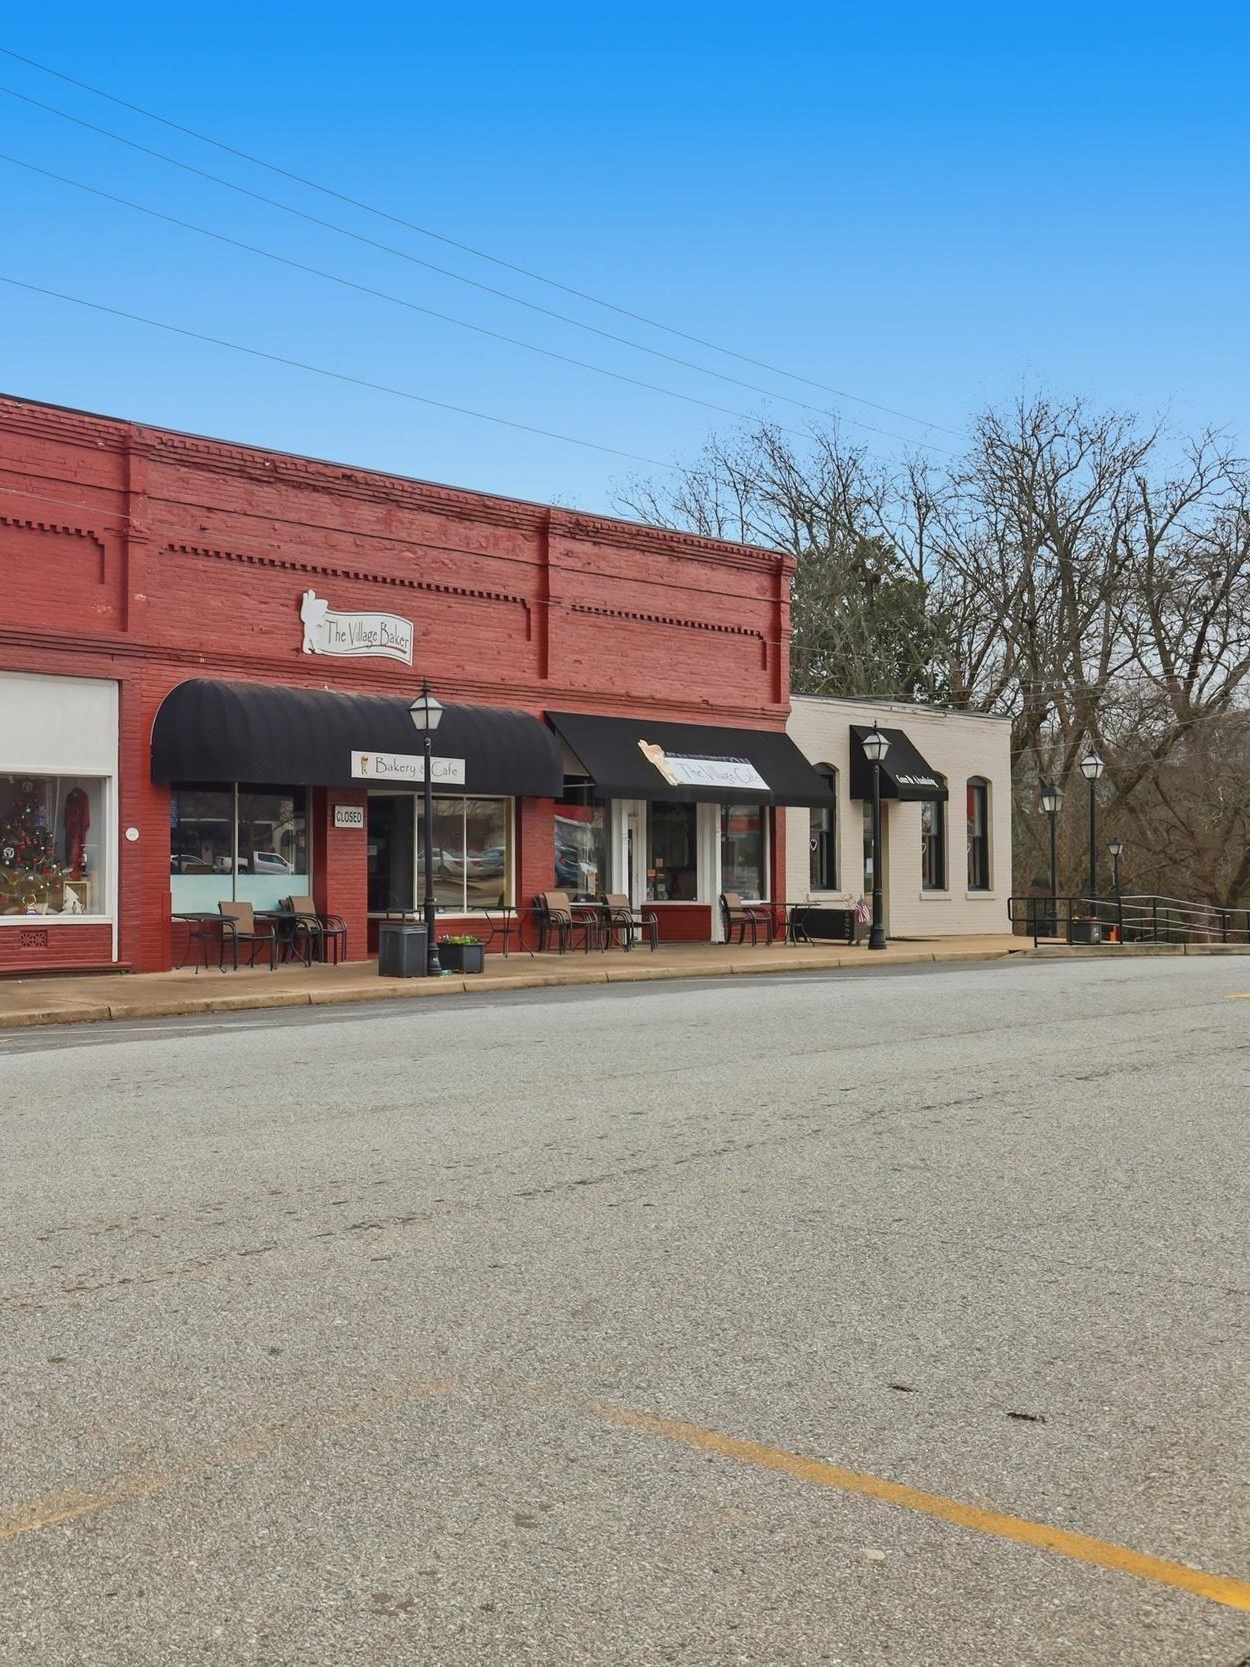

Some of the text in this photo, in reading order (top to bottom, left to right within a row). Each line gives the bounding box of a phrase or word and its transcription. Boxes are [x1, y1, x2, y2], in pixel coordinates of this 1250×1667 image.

[325, 620, 410, 649] The Village Baker
[375, 756, 416, 777] Bakery
[336, 811, 362, 823] CLOSED
